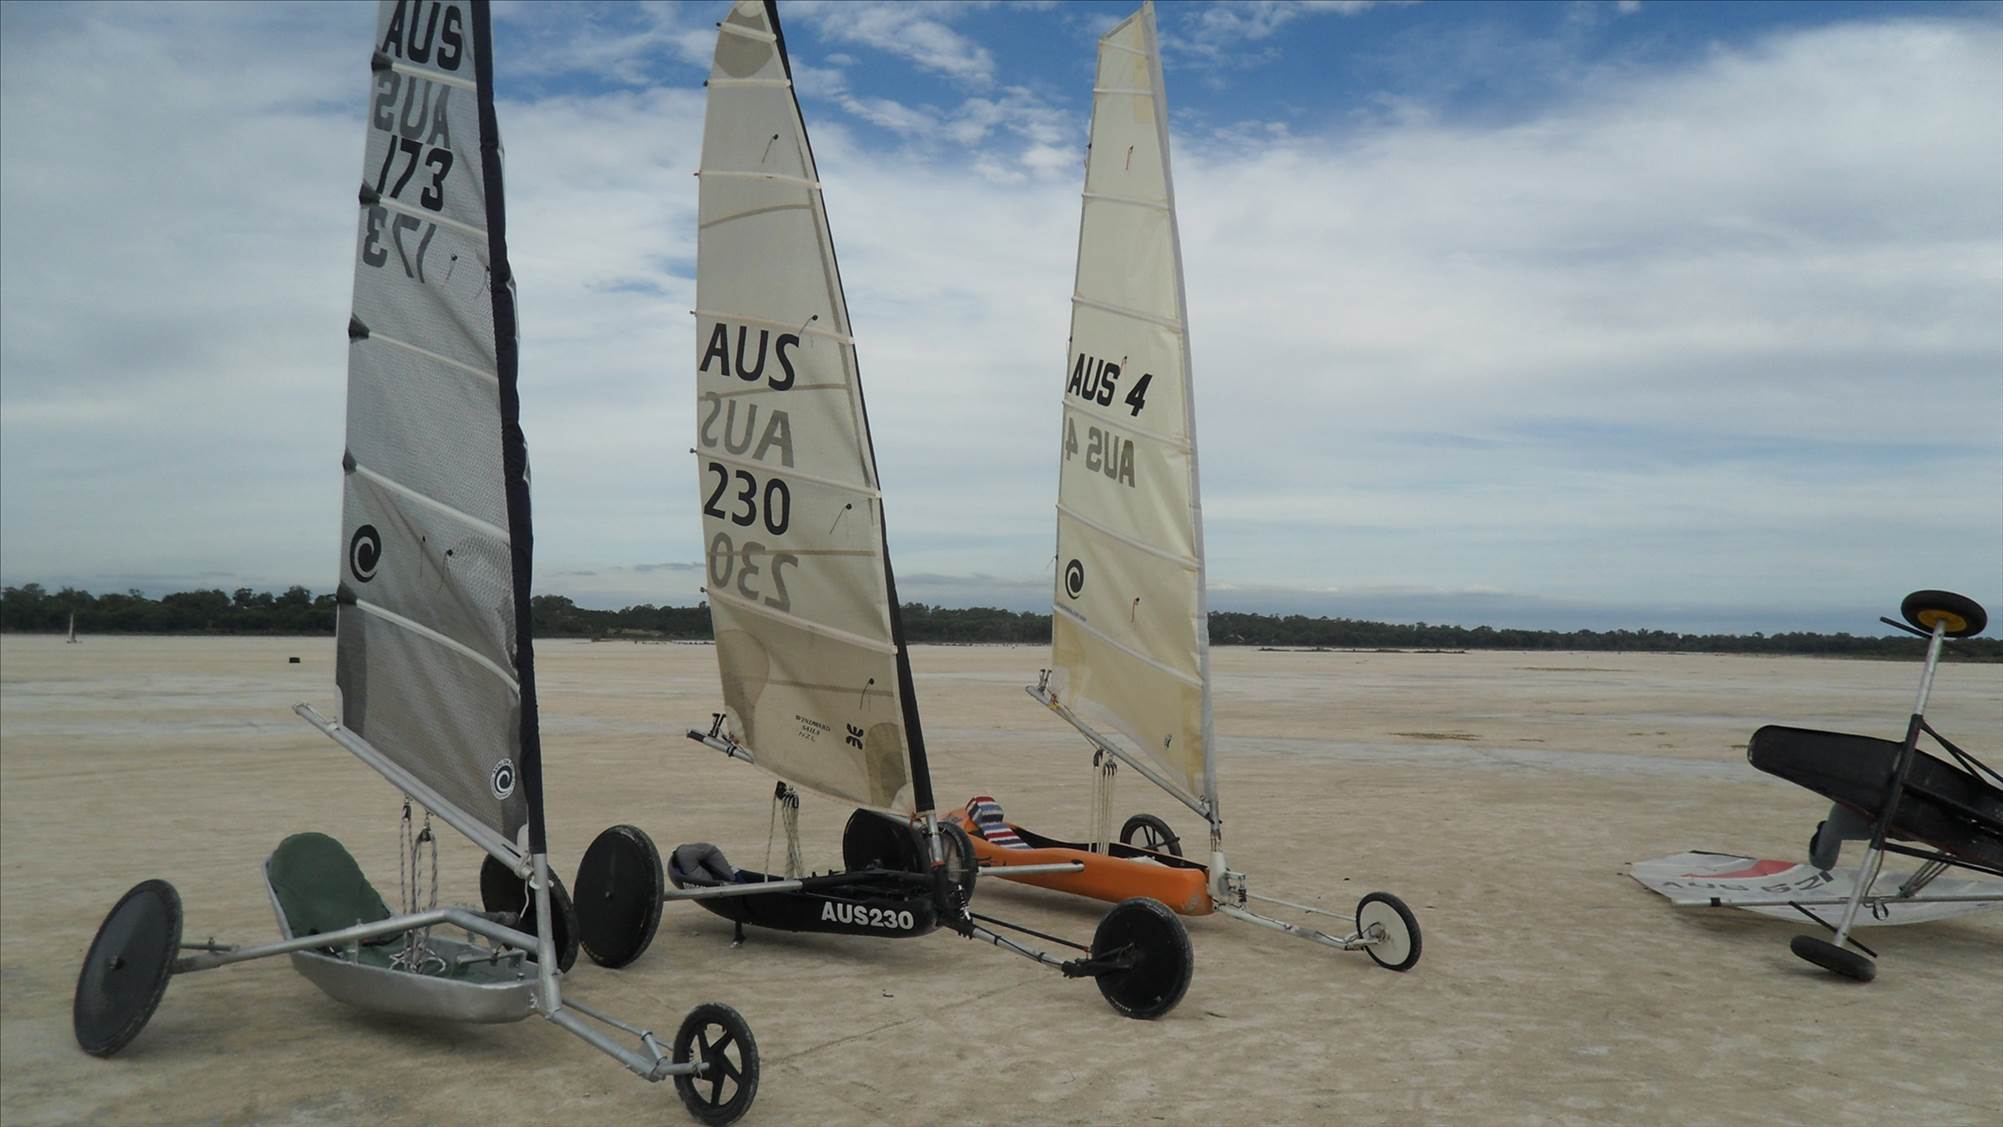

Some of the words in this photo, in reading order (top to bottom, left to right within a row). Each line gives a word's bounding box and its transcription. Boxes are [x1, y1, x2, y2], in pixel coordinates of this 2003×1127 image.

[383, 0, 462, 71] AUS
[376, 135, 453, 212] 173
[700, 322, 799, 391] AUS
[1068, 353, 1121, 407] AUS
[1125, 373, 1153, 417] 4
[704, 462, 791, 536] 230
[821, 901, 914, 930] AUS230
